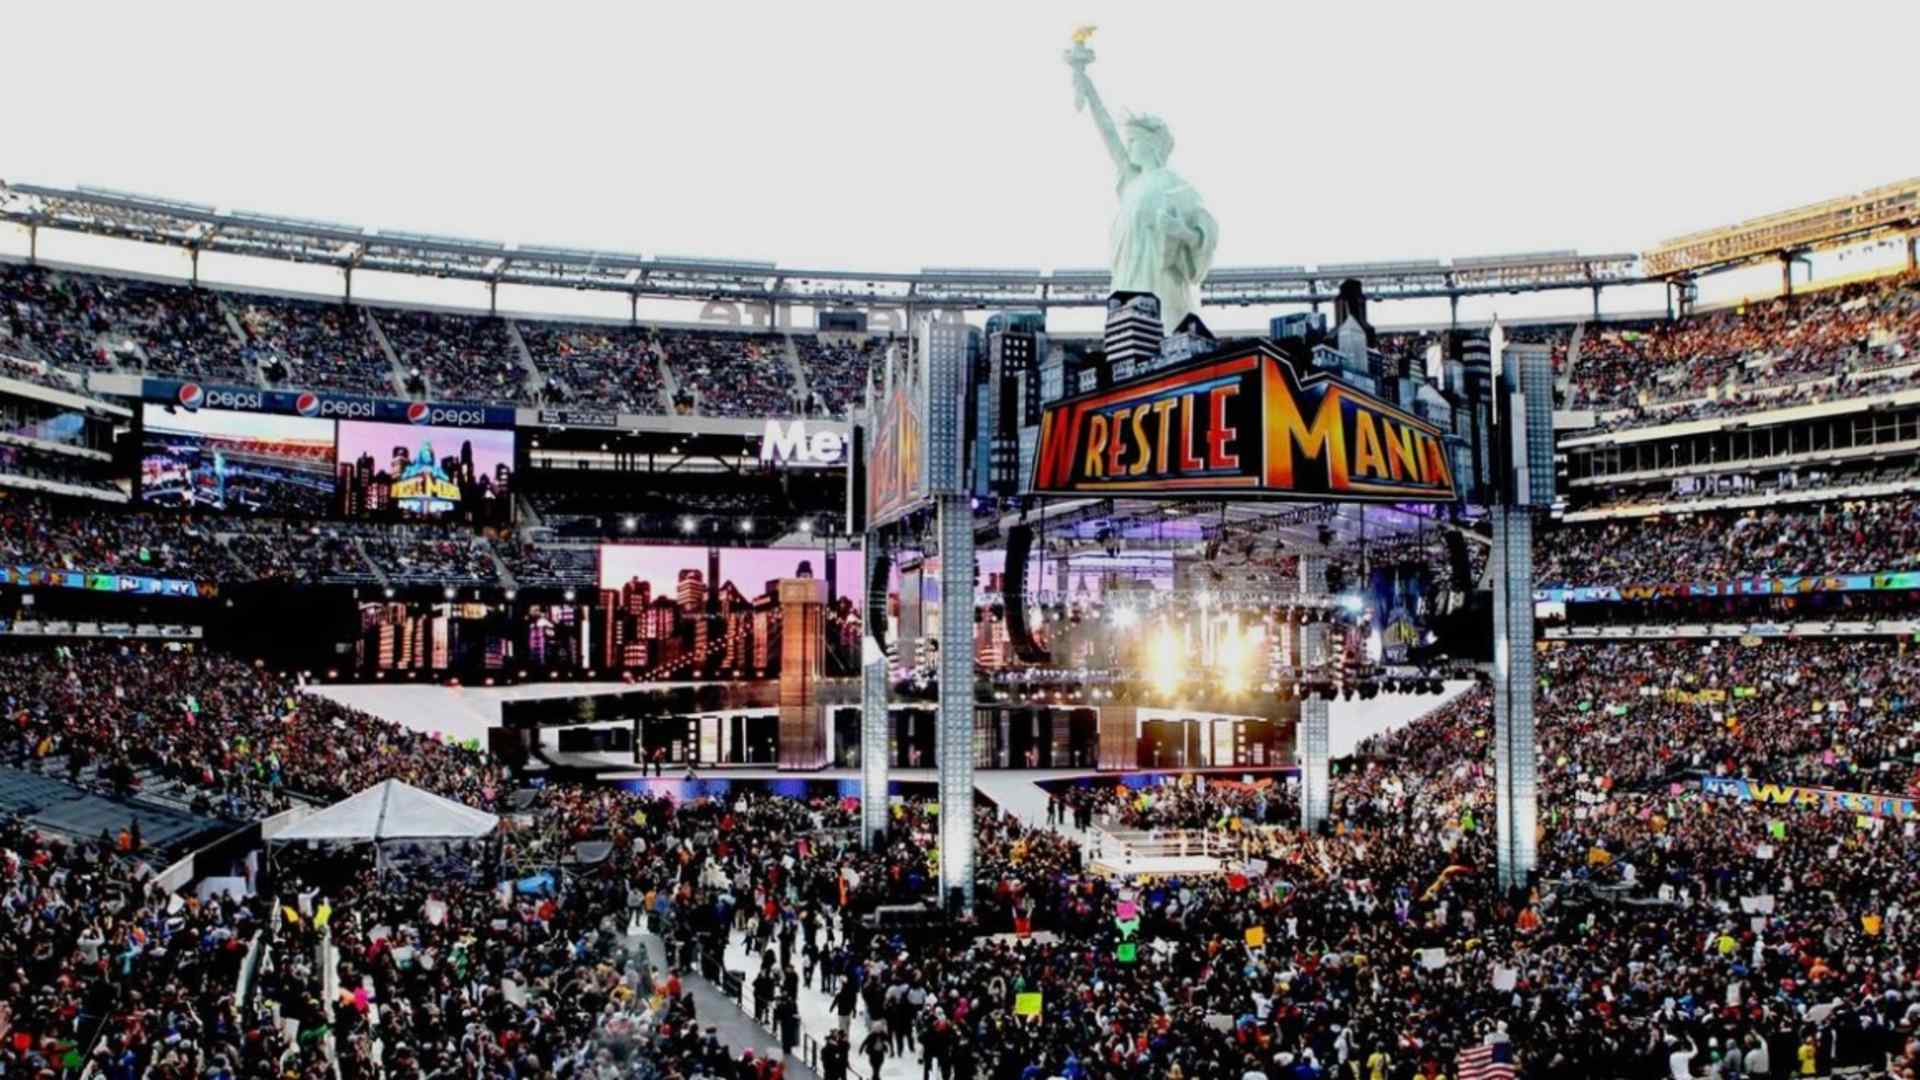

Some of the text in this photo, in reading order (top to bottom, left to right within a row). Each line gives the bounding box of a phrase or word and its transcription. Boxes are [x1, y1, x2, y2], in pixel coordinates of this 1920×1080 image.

[206, 390, 262, 409] pepsi
[321, 400, 376, 418] pepsi
[431, 408, 486, 426] pepsi
[760, 419, 848, 462] Me
